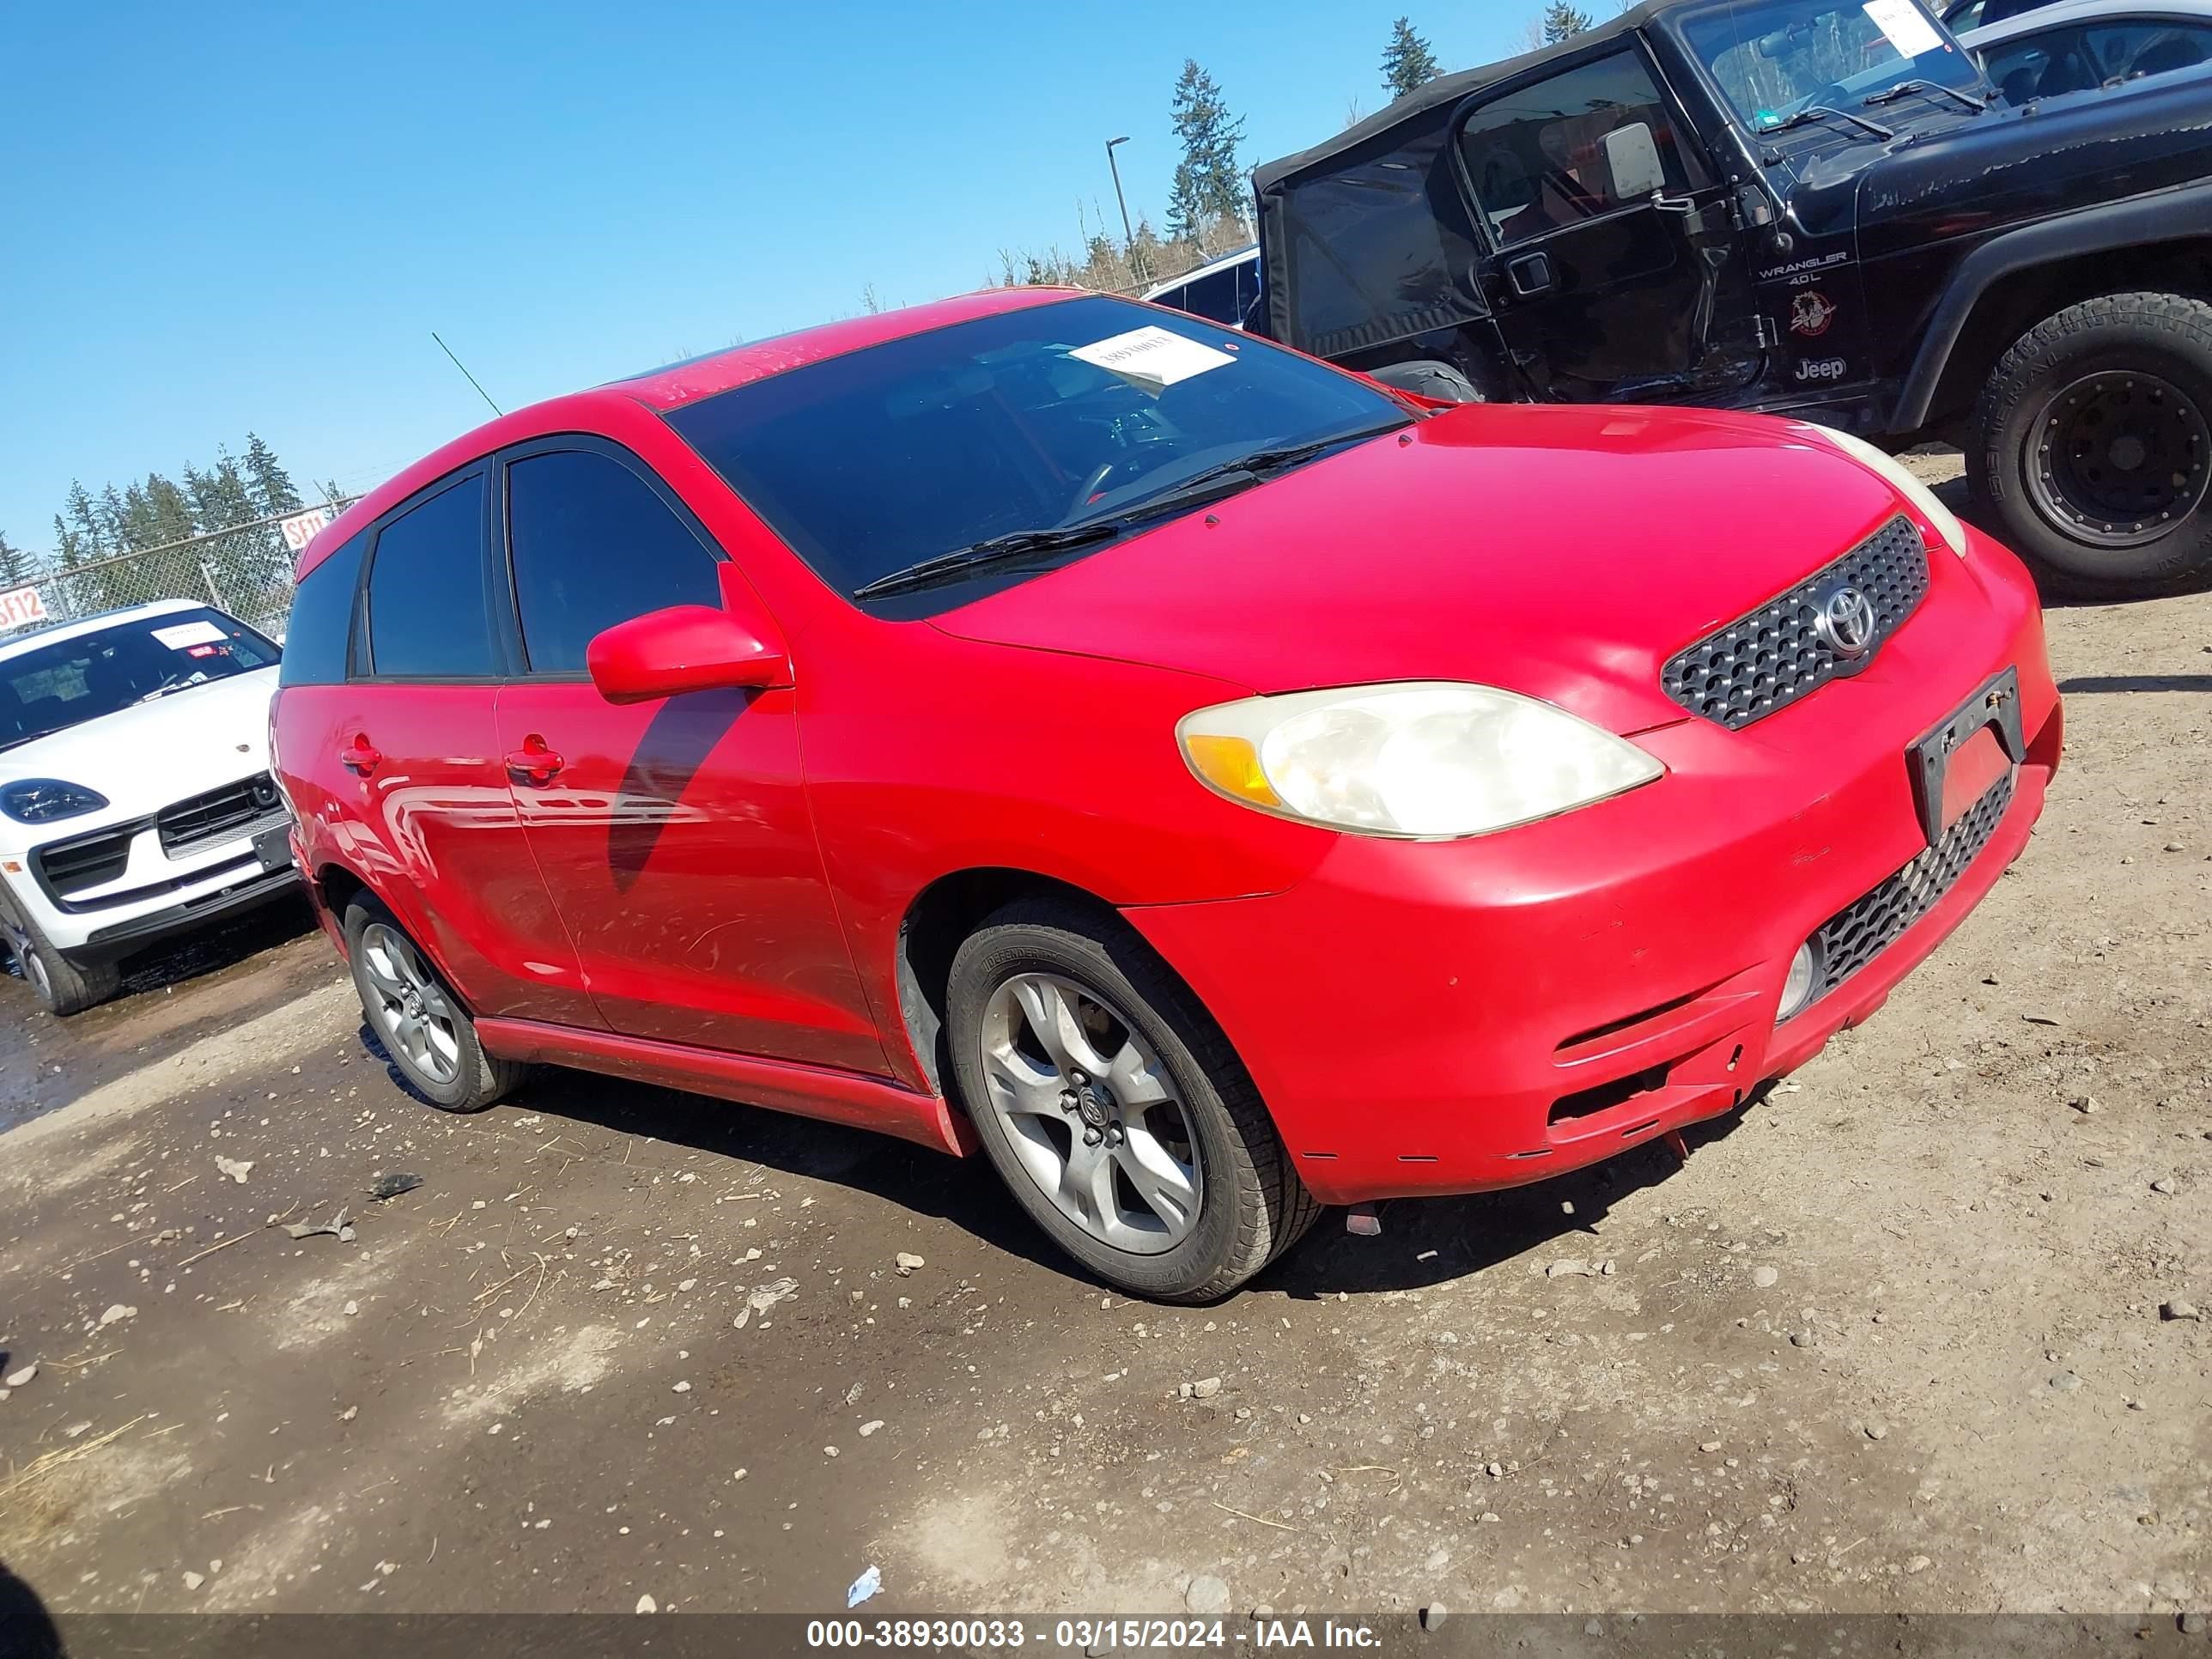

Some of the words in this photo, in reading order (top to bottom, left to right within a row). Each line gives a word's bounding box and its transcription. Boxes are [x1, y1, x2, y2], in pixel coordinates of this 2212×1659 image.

[1758, 251, 1848, 278] WRANGLER
[1795, 361, 1844, 380] Jeep
[286, 515, 323, 544] SF11
[987, 947, 1039, 968] DEFENDER
